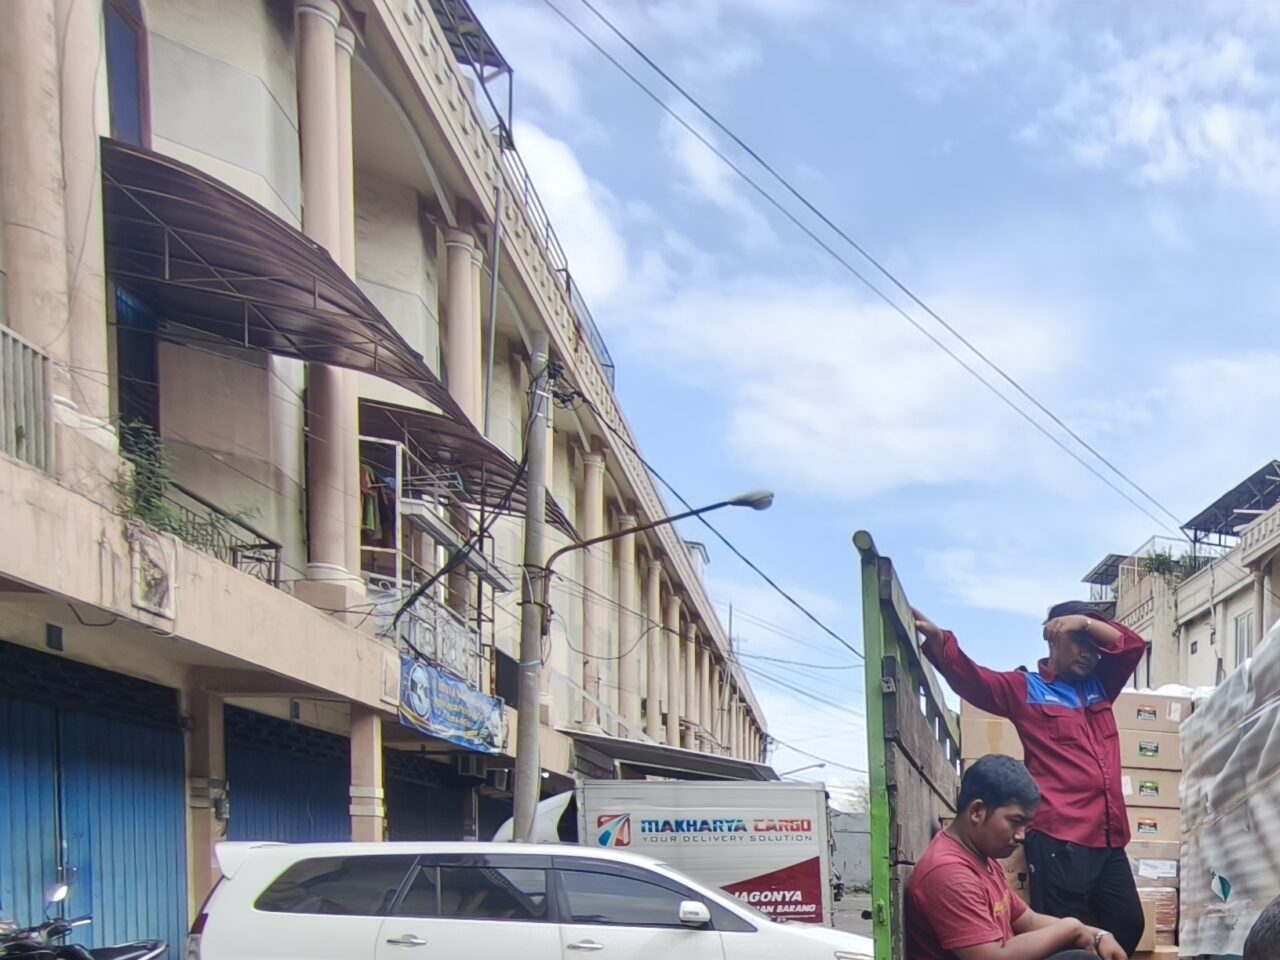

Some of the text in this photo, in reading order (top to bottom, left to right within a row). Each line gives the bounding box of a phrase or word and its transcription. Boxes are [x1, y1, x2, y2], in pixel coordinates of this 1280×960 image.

[641, 819, 812, 832] MAKHARYA CARGO
[642, 834, 813, 843] YOUR DELIVERY SOLUTION
[776, 904, 817, 913] BARANG
